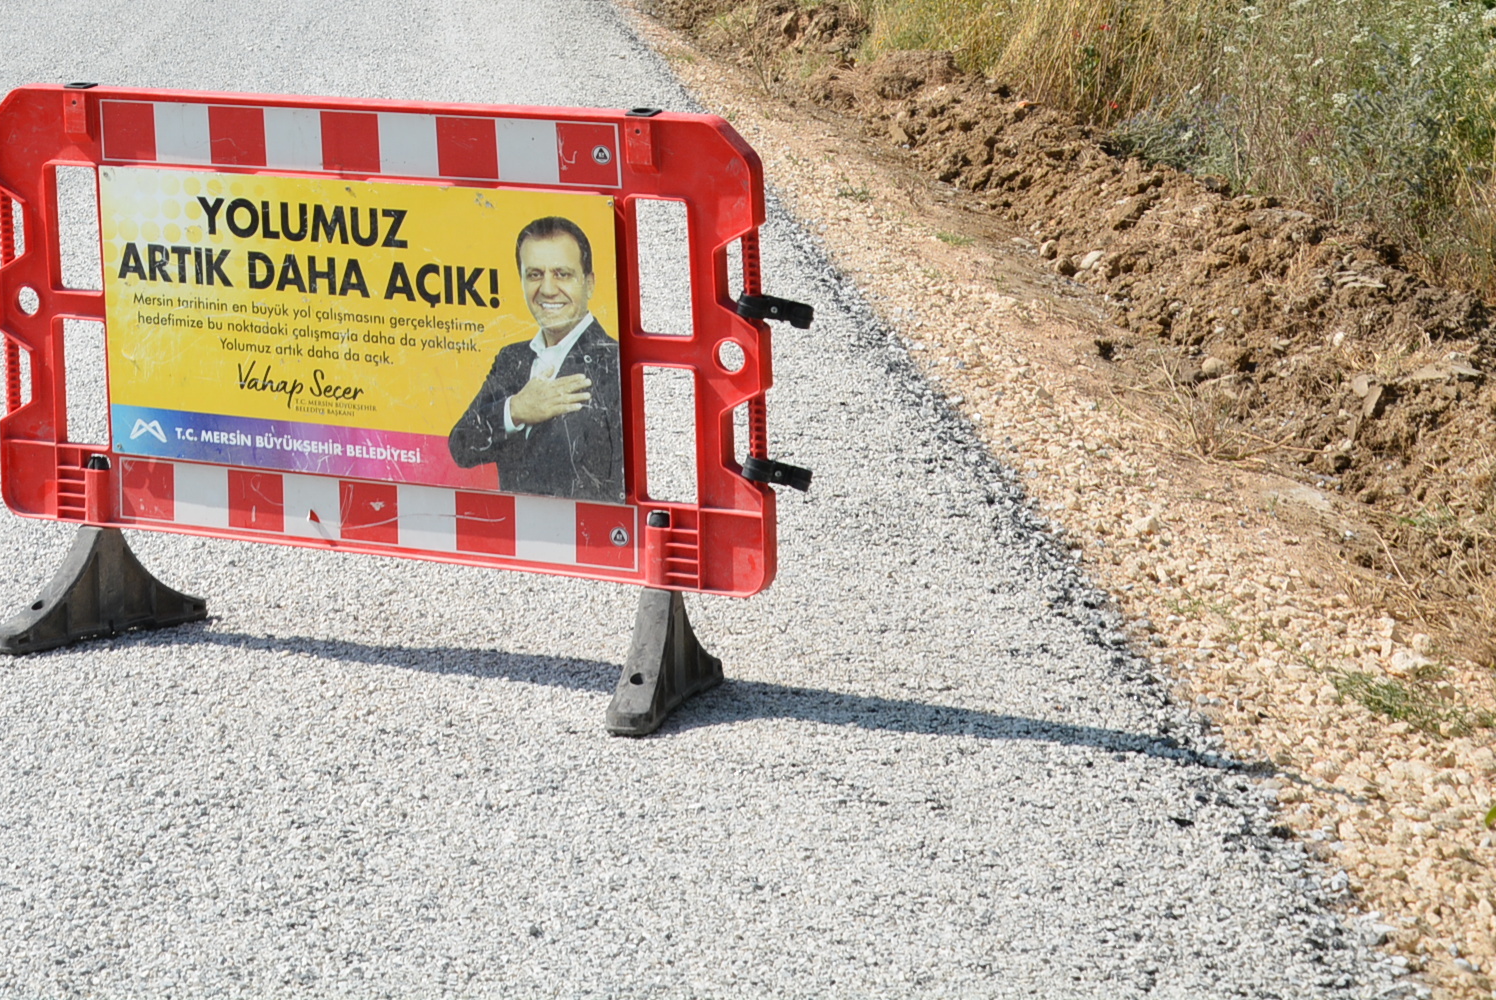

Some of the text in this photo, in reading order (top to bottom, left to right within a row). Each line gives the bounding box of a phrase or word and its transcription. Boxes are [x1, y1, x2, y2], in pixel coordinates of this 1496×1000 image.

[196, 196, 408, 249] YOLUMUZ
[117, 242, 501, 310] ARTIK DAHA AÇIK!
[133, 293, 485, 334] Mersin tarihinin en büyük yol çalışmasını gerçekleştirme
[137, 311, 482, 354] hedefimize bu noktadaki çalışmayla daha da yaklaştık.
[219, 336, 394, 366] Yolumuz artık daha da açık.
[238, 360, 365, 409] Vahap Seçer
[175, 427, 421, 463] T.C. MERSİN BÜYÜKŞEHİR BELEDİYESİ
